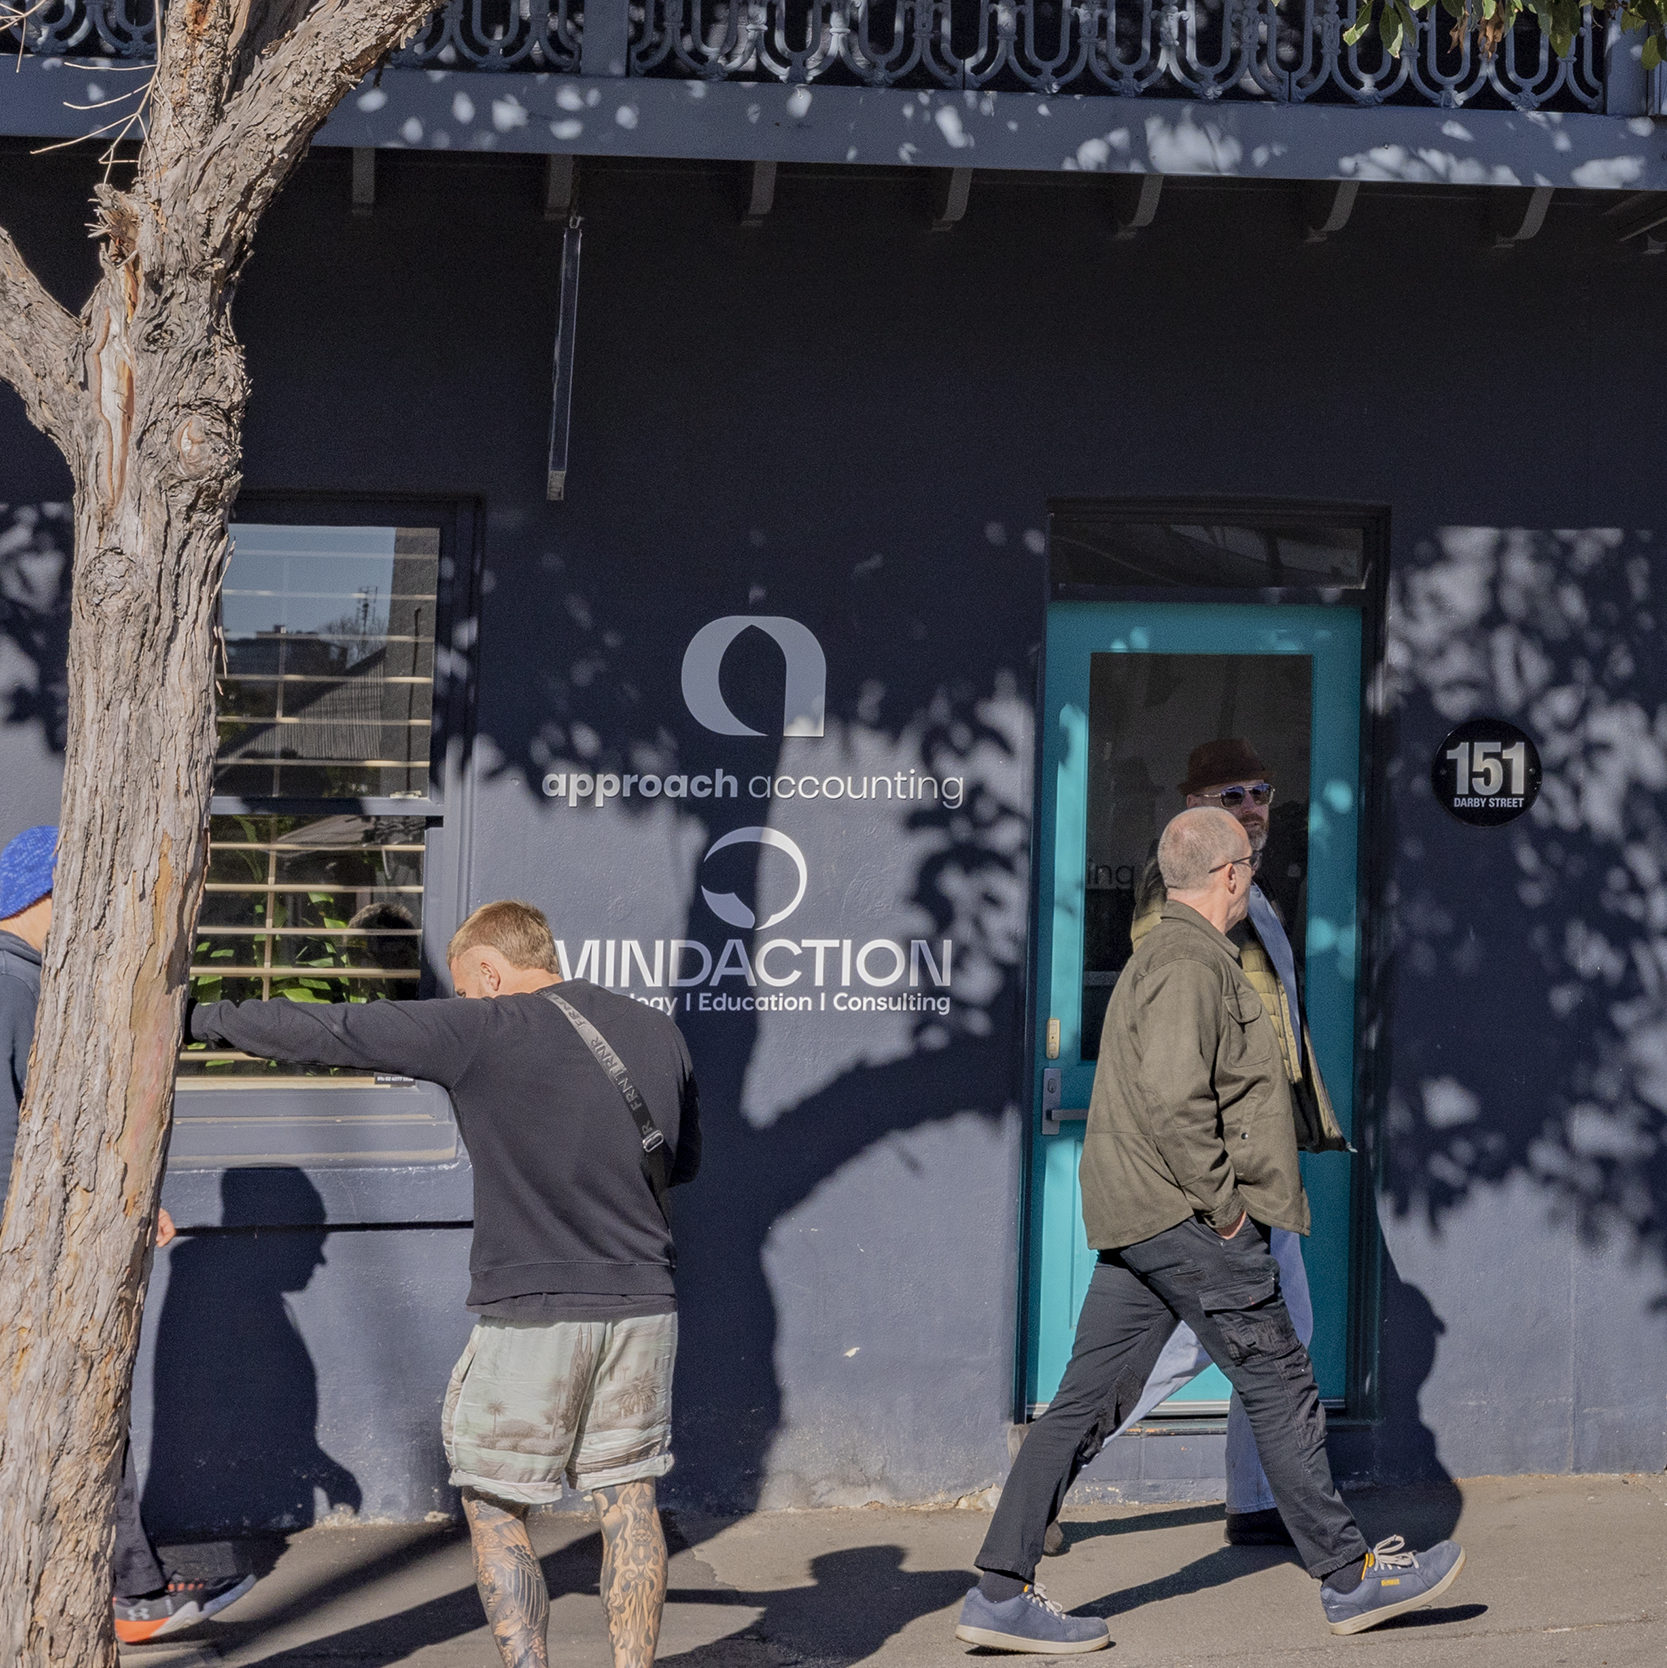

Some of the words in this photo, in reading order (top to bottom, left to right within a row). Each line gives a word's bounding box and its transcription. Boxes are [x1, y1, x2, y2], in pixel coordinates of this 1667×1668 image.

[542, 768, 738, 807] approach
[748, 768, 965, 809] accounting
[1446, 742, 1525, 796] 151
[1453, 797, 1487, 808] DARBY
[1488, 797, 1525, 808] STREET
[556, 938, 952, 988] MINDACTION
[698, 992, 812, 1011] Education
[832, 992, 952, 1015] Consulting
